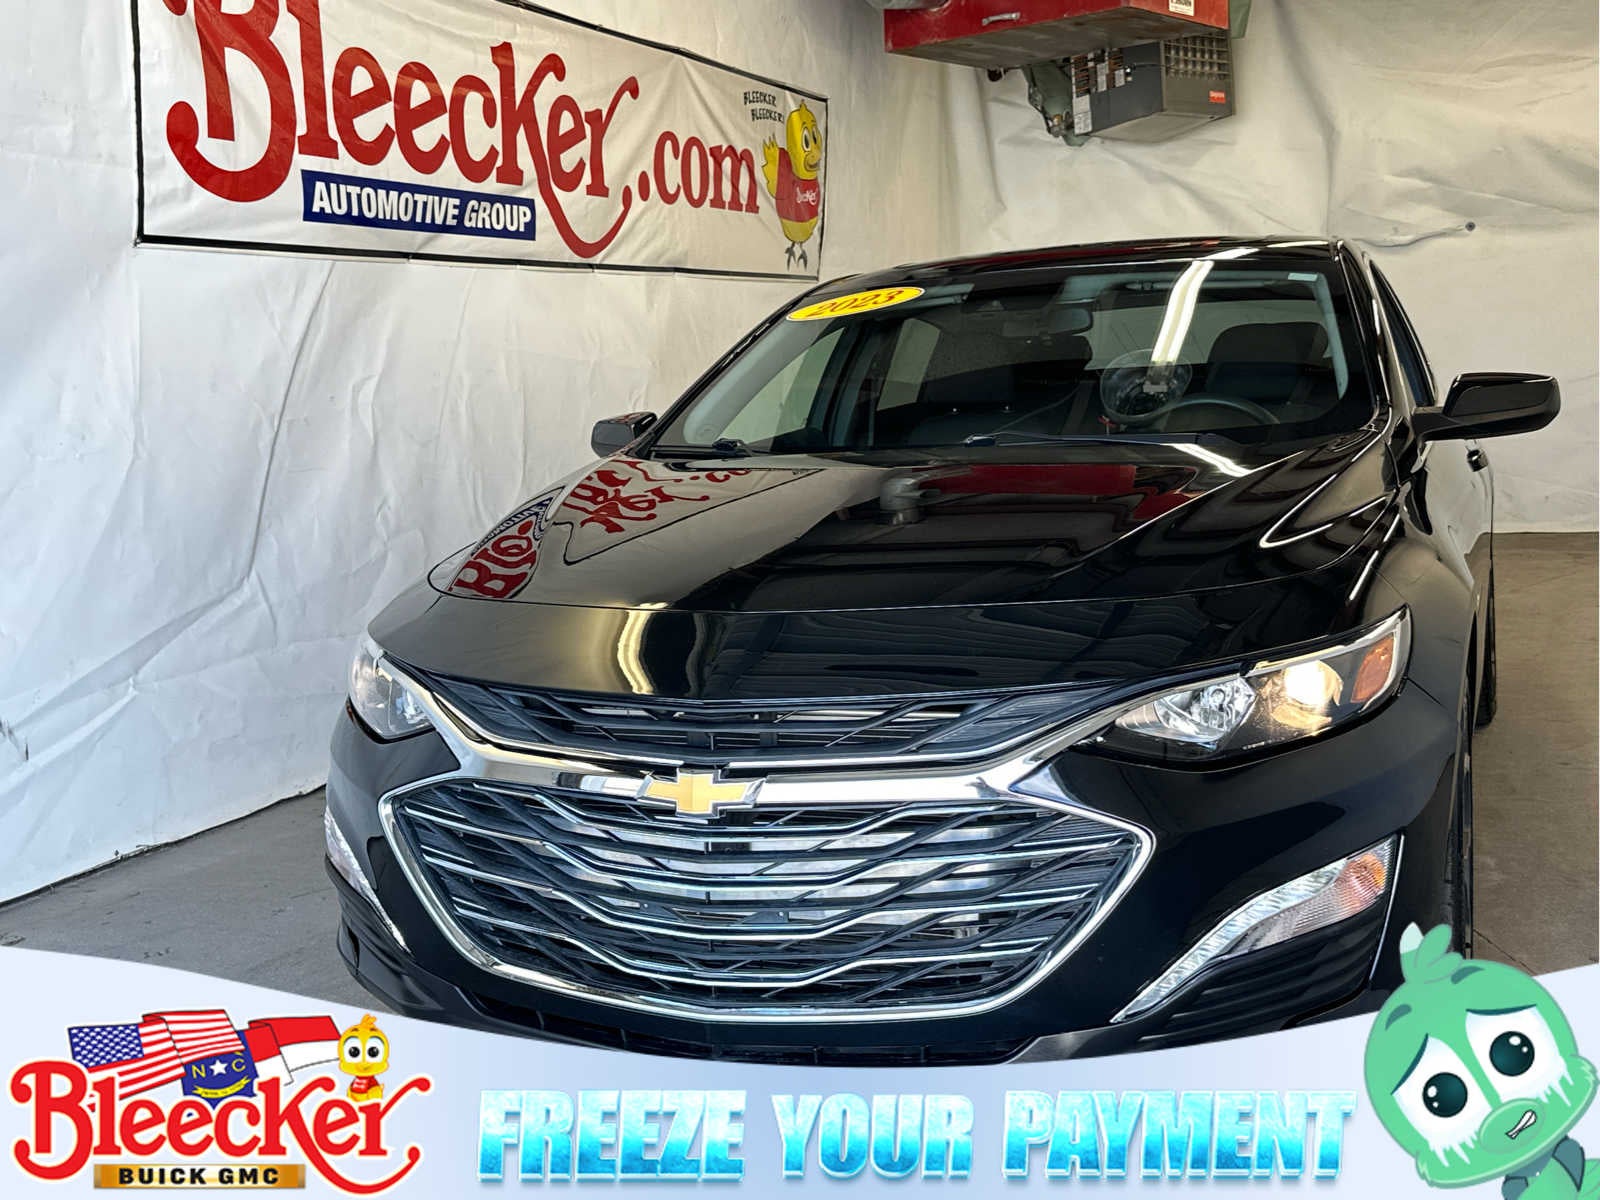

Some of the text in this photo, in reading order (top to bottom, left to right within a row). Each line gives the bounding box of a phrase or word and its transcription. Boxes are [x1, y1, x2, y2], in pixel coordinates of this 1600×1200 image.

[312, 181, 534, 233] AUTOMOTIVE GROUP
[805, 289, 905, 317] 2023
